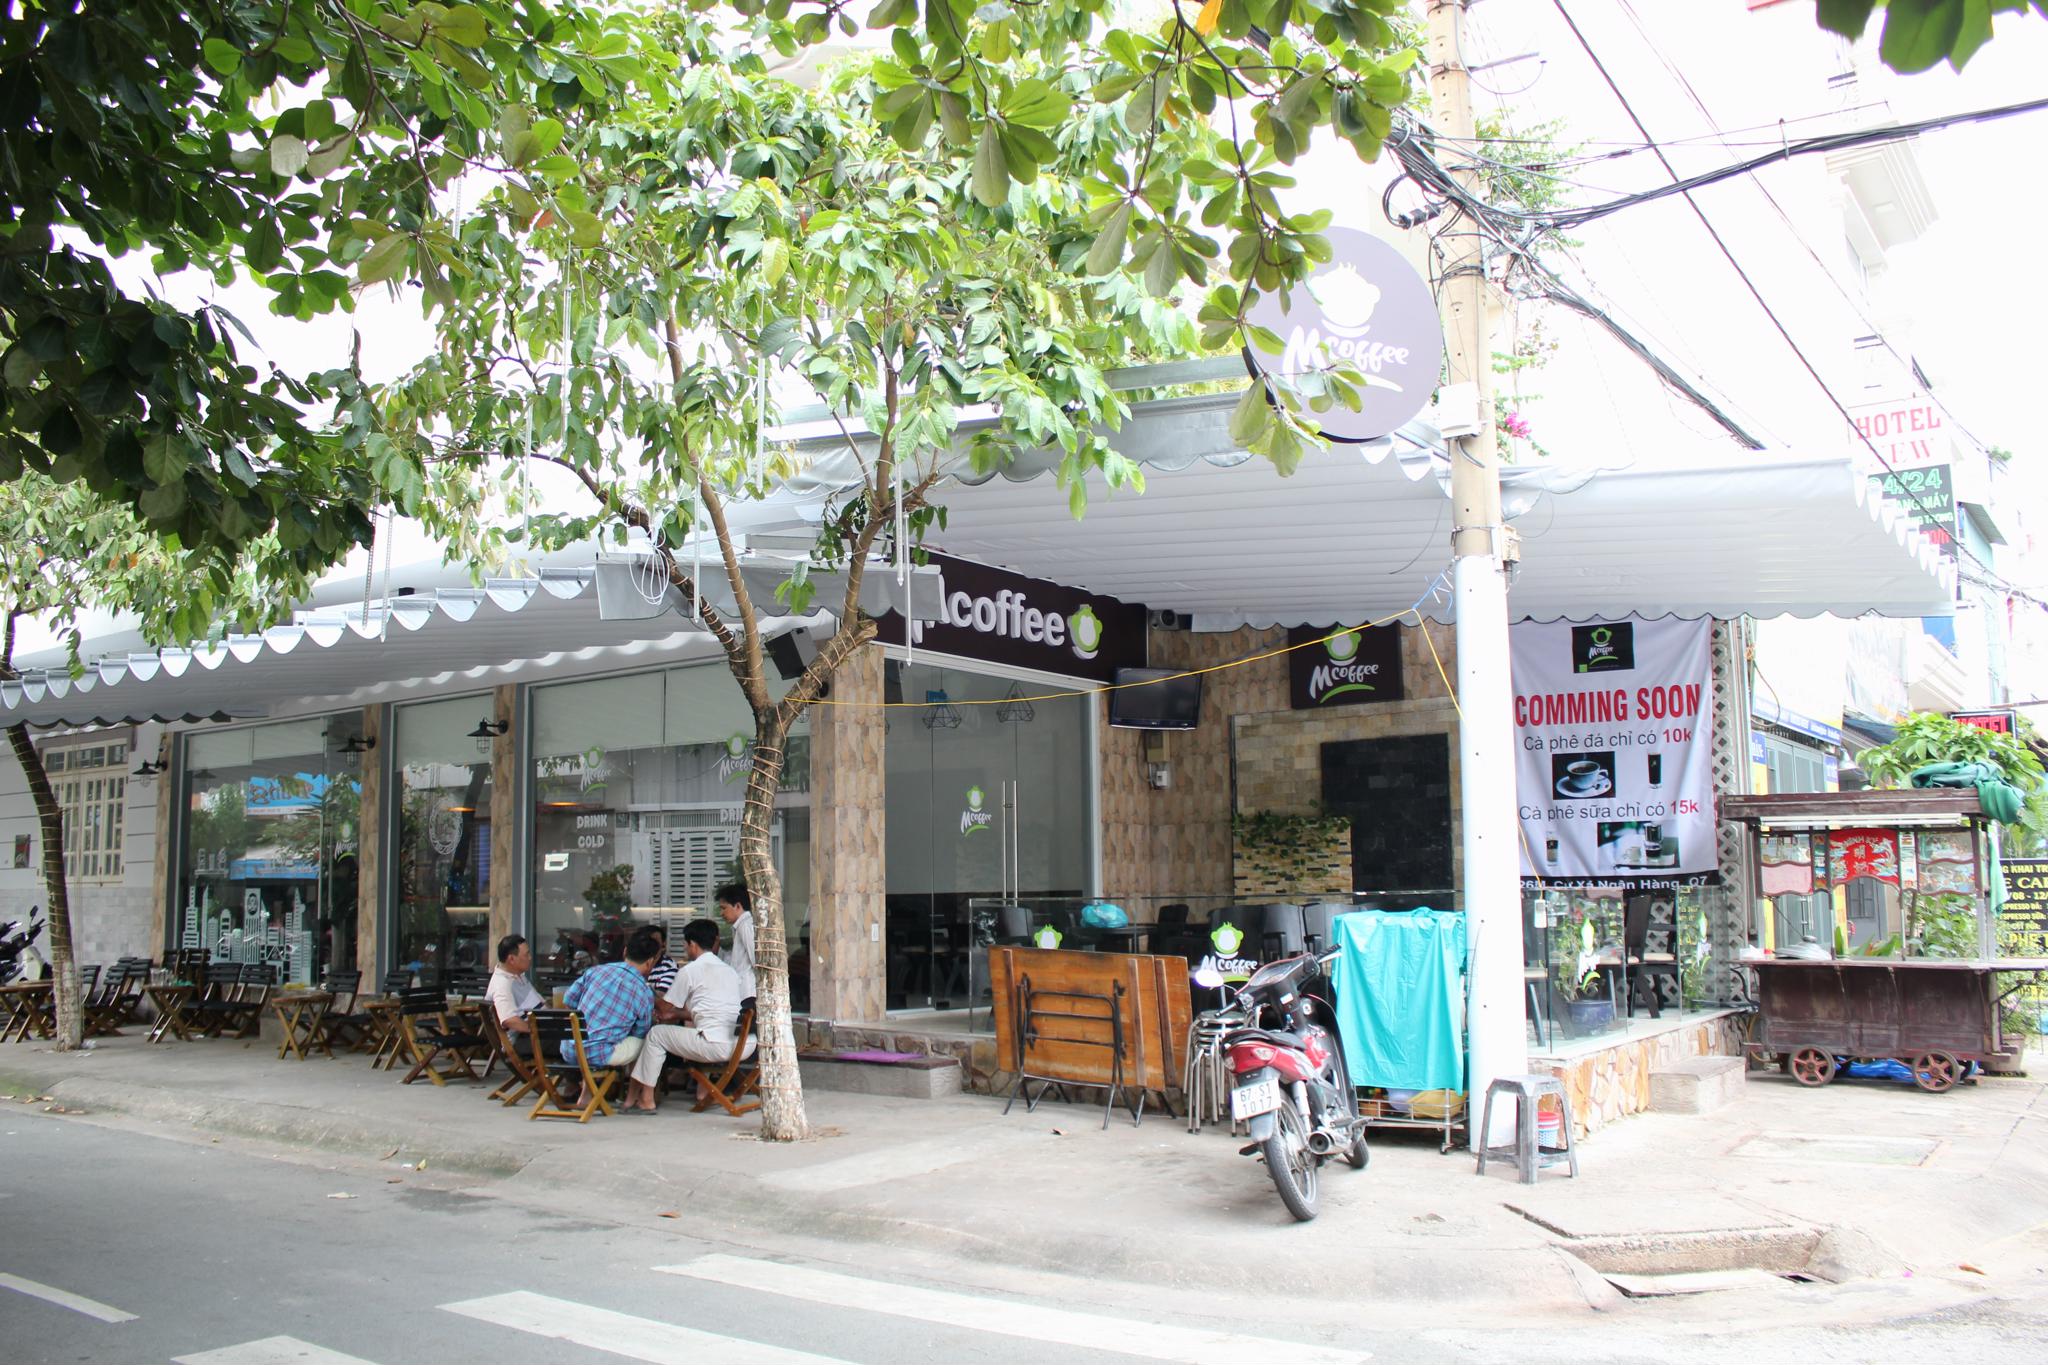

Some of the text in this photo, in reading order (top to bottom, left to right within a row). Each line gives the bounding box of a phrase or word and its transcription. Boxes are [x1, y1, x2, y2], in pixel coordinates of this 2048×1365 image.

[1856, 406, 1941, 440] HOTEL
[1309, 664, 1379, 699] Mcoffee
[1515, 683, 1701, 728] COMMING SOON
[1523, 728, 1692, 753] Cà phê đá chỉ có 10k
[576, 814, 608, 829] DRINK
[1519, 799, 1700, 822] Cà phê sữa chỉ có 15k
[578, 834, 605, 849] COLD
[1689, 876, 1708, 889] Q7
[1243, 1095, 1272, 1116] 1017
